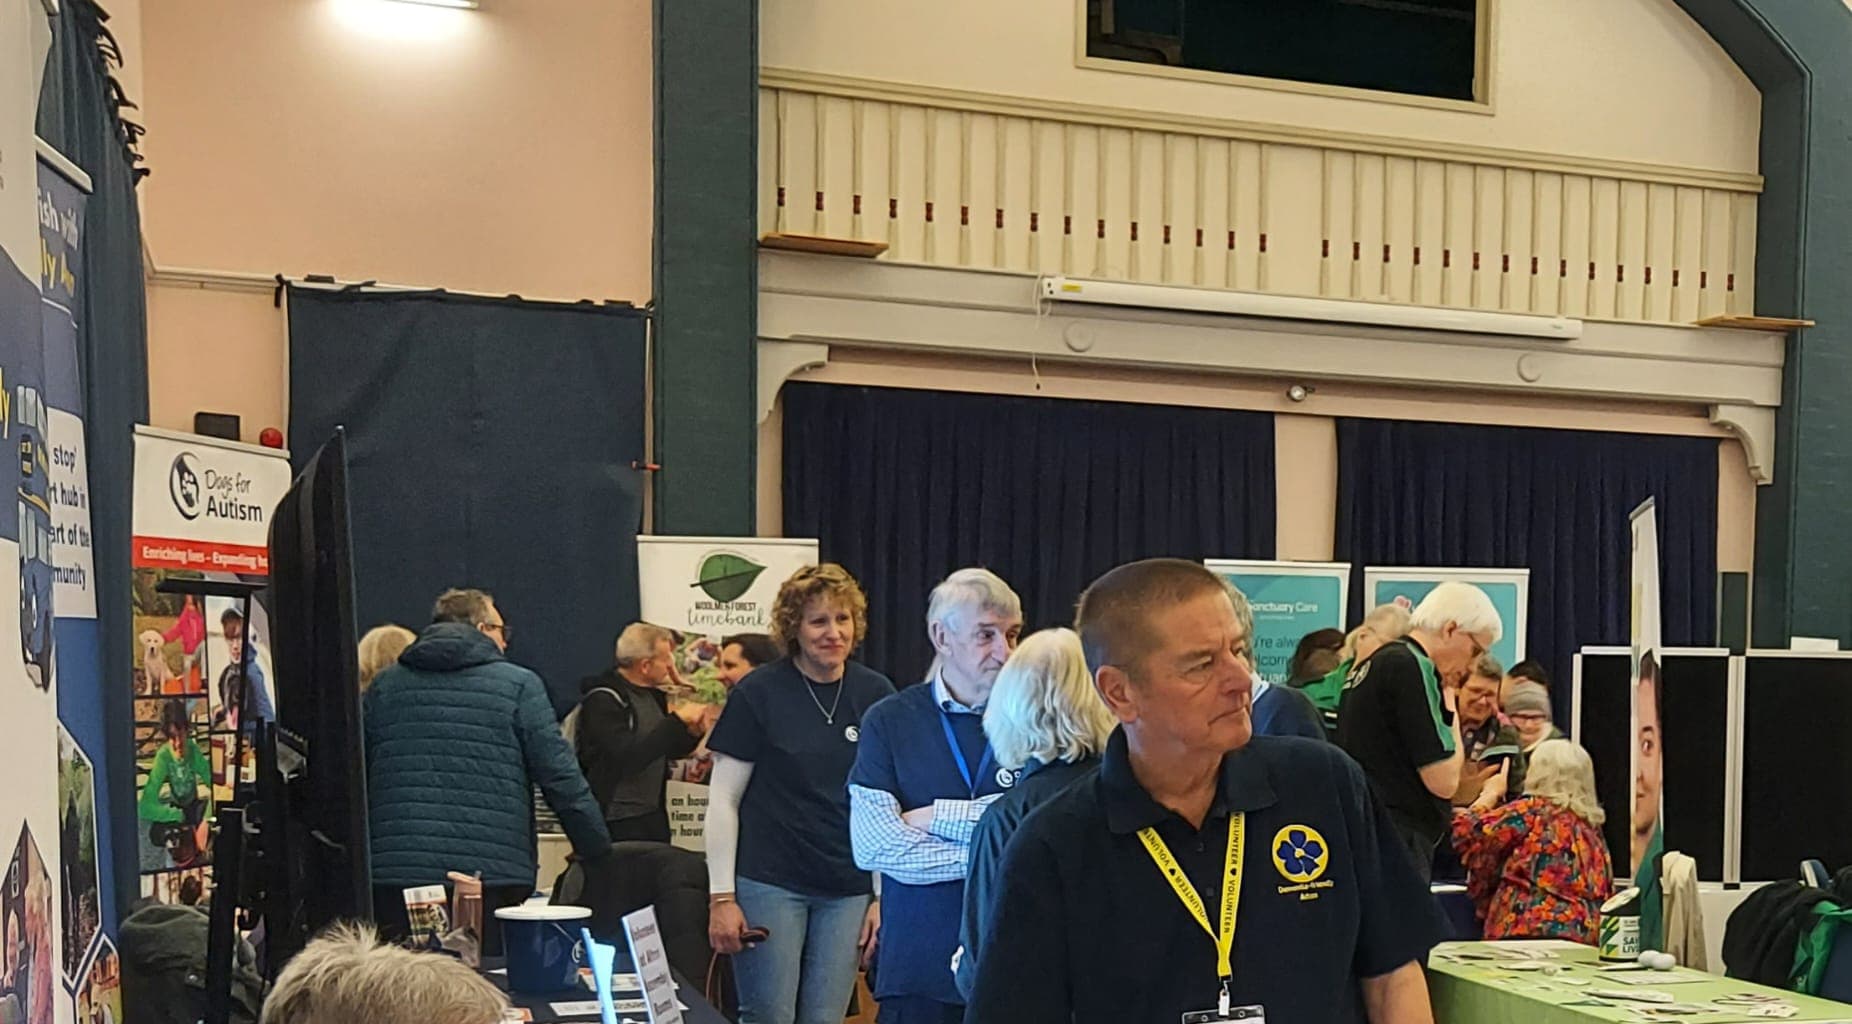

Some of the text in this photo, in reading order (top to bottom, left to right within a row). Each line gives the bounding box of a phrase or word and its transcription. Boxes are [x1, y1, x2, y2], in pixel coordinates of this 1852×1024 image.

[204, 469, 252, 499] Dogs for
[206, 495, 263, 522] Autism
[53, 565, 87, 590] munity
[1296, 601, 1319, 613] Care
[1275, 635, 1299, 649] alw
[671, 810, 694, 822] time
[680, 824, 704, 837] hour
[1223, 812, 1242, 934] VOLUNTEER VOLUNTEER
